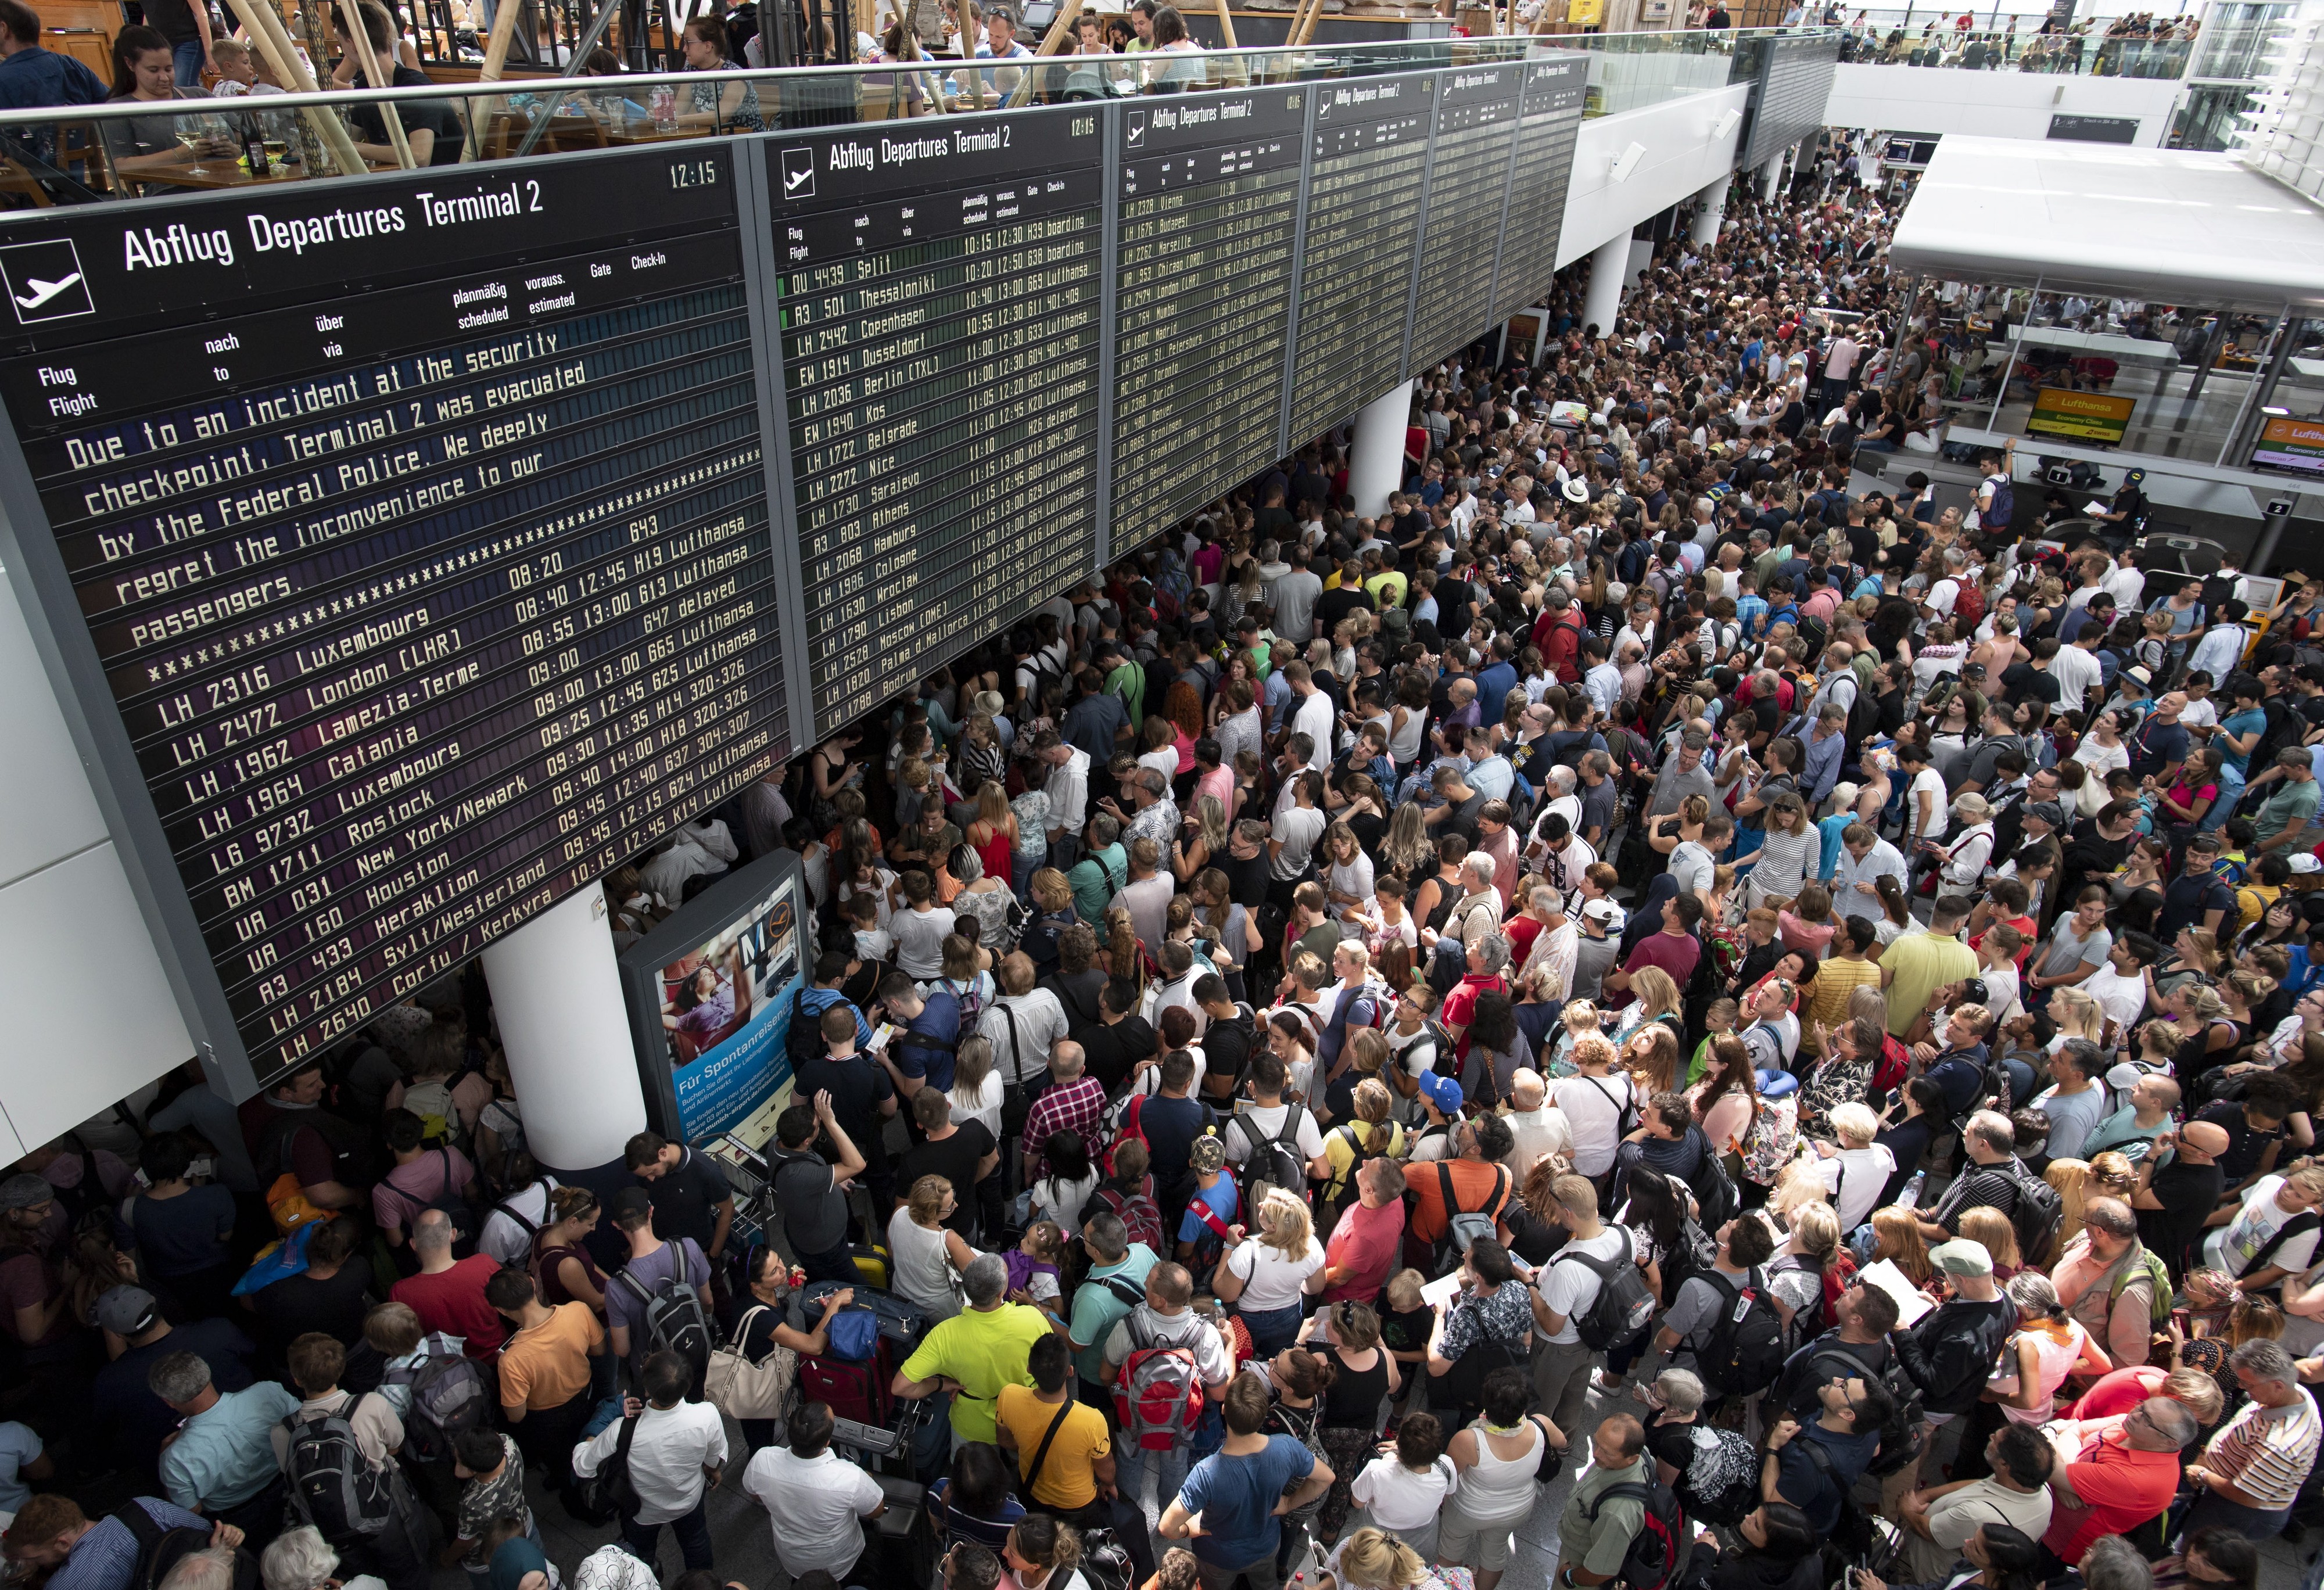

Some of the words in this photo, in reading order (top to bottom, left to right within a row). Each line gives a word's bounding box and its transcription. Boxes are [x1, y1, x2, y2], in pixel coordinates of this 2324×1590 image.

[1152, 108, 1177, 130] Abflug
[1180, 106, 1217, 128] Departures
[1220, 100, 1246, 120] Terminal
[1247, 99, 1252, 116] 2
[1287, 95, 1301, 109] 12:15
[1335, 89, 1351, 107] Abflug
[1353, 88, 1377, 105] Departures
[1378, 83, 1396, 99] Terminal
[1396, 82, 1400, 97] 2
[830, 142, 874, 171] Abflug
[881, 138, 948, 167] Departures
[953, 126, 1000, 153] Terminal
[1003, 125, 1010, 148] 2
[1072, 117, 1094, 137] 12:15
[670, 161, 715, 188] 12:15
[125, 224, 235, 271] Abflug
[248, 207, 406, 253] Departures
[416, 175, 521, 227] Terminal
[526, 180, 544, 212] 2
[788, 227, 803, 241] Flug
[855, 214, 869, 228] nach
[902, 207, 914, 219] über
[963, 193, 988, 210] planmäßig
[996, 191, 1016, 202] vorauss.
[1027, 185, 1038, 196] Gate
[1047, 180, 1065, 193] Check-In
[790, 246, 809, 261] Flight
[856, 236, 863, 247] to
[903, 225, 912, 237] via
[963, 210, 987, 225] scheduled
[996, 204, 1019, 218] estimated
[815, 265, 844, 289] 4439
[858, 254, 890, 279] Split
[965, 232, 991, 255] 10:15
[998, 226, 1023, 247] 12:30
[1028, 222, 1043, 241] H39
[1048, 215, 1084, 236] boarding
[38, 367, 78, 387] Flug
[205, 333, 240, 354] nach
[315, 315, 344, 332] über
[453, 282, 508, 308] planmäßig
[525, 274, 566, 290] vorauss.
[590, 264, 612, 278] Gate
[632, 252, 666, 270] Check-In
[49, 393, 98, 417] Flight
[213, 367, 230, 382] to
[323, 341, 343, 358] via
[458, 305, 509, 329] scheduled
[529, 292, 575, 314] estimated
[66, 436, 126, 469] Due
[144, 422, 179, 450] to
[193, 412, 228, 439] an
[245, 375, 360, 426] incident
[375, 365, 401, 394] at
[417, 357, 454, 384] the
[466, 332, 557, 372] security
[284, 410, 397, 461] Terminal
[410, 402, 425, 428] 2
[436, 395, 474, 421] was
[486, 361, 586, 408] evacuated
[2056, 414, 2085, 423] Economy
[2061, 398, 2112, 412] Lufthansa
[809, 480, 824, 502] LH
[830, 467, 857, 494] 2272
[869, 455, 895, 478] Nice
[970, 413, 994, 437] 11:10
[1000, 401, 1024, 425] 12:45
[1028, 394, 1042, 414] K20
[1047, 380, 1086, 406] Lufthansa
[2035, 422, 2058, 430] Austrian
[2261, 454, 2287, 462] Austrian
[2285, 446, 2318, 456] Economy
[2291, 466, 2320, 475] ALLIANCE
[98, 533, 134, 561] by
[156, 513, 206, 544] the
[218, 473, 325, 526] Federal
[338, 451, 430, 491] Police.
[443, 435, 469, 460] We
[481, 412, 547, 449] deeply
[2056, 473, 2060, 481] 1
[116, 551, 217, 605] regret
[235, 536, 280, 566] the
[295, 478, 465, 547] inconvenience
[478, 466, 501, 487] to
[511, 453, 543, 478] our
[2275, 505, 2281, 513] 2
[131, 576, 302, 648] passengers.
[826, 685, 840, 705] LH
[847, 667, 870, 694] 1820
[881, 648, 910, 673] Palma
[974, 594, 997, 619] 11:20
[1002, 579, 1024, 603] 12:20
[1028, 569, 1042, 587] K22
[1046, 548, 1083, 577] Lufthansa
[172, 733, 207, 766] LH
[219, 702, 282, 747] 2472
[307, 663, 389, 710] London
[515, 584, 569, 623] 08:40
[579, 561, 626, 597] 12:45
[634, 546, 662, 573] H19
[670, 516, 745, 558] Lufthansa
[793, 744, 801, 752] AEG
[235, 910, 267, 941] UA
[356, 846, 395, 878] New
[406, 775, 528, 850] York/Newark
[547, 737, 596, 777] 09:30
[605, 708, 649, 746] 11:35
[656, 691, 683, 719] H14
[690, 658, 745, 701] 320-326
[679, 1074, 701, 1094] Für
[682, 1089, 705, 1106] Buchen
[706, 1081, 716, 1092] Sie
[716, 1068, 733, 1085] direkt
[733, 1064, 741, 1072] Ihr
[683, 1101, 695, 1114] und
[697, 1079, 733, 1106] Airlinemarkt.
[686, 1119, 696, 1129] Sie
[697, 1107, 716, 1121] finden
[716, 1096, 727, 1109] den
[728, 1089, 739, 1100] neu
[740, 1066, 767, 1093] gestalteten
[687, 1121, 706, 1136] Ebene
[706, 1114, 715, 1124] 03
[716, 1108, 726, 1118] am
[726, 1099, 737, 1114] Ein-
[738, 1089, 749, 1101] und
[749, 1071, 770, 1092] Ausgang
